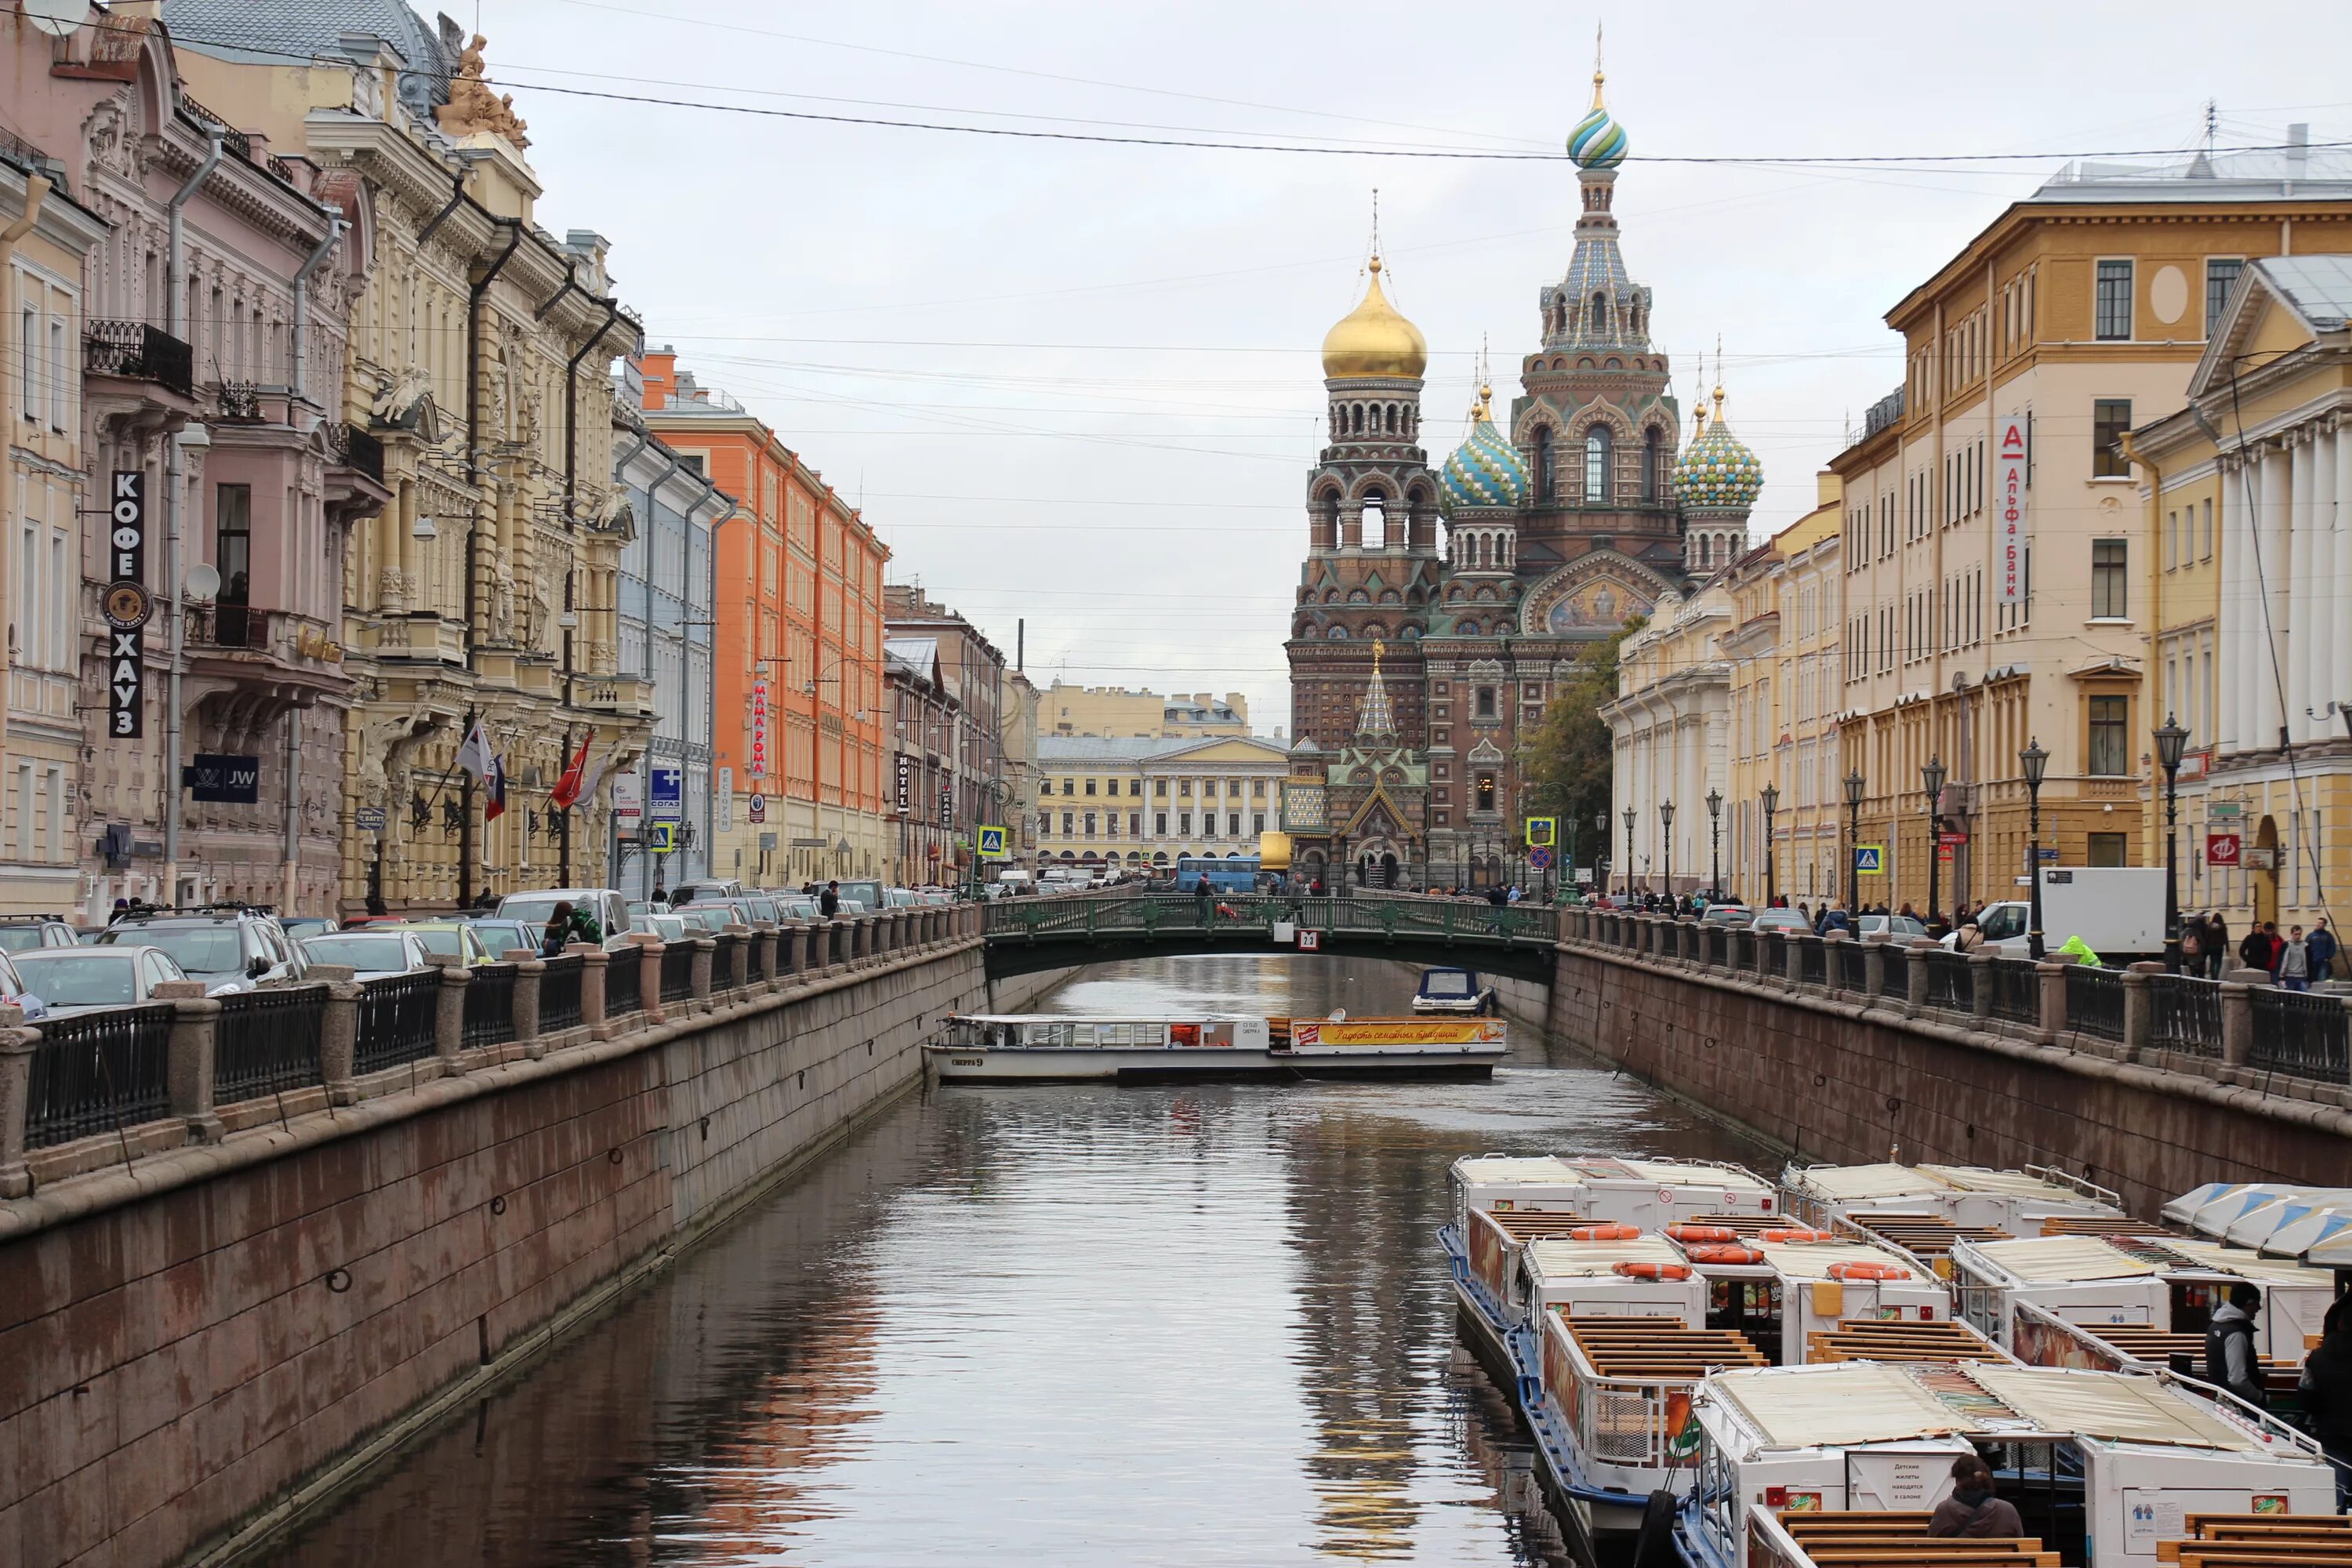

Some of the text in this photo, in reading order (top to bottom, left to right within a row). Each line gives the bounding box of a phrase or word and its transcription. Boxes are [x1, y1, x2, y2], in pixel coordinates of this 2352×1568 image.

[114, 474, 139, 575] КОФЕ
[112, 633, 138, 734] ХАУЗ
[753, 685, 766, 774] МАМА РОМА
[229, 771, 256, 785] JW
[899, 757, 908, 806] HOTEL
[1334, 1029, 1459, 1041] Радость семейных традиций
[976, 1058, 984, 1067] 9
